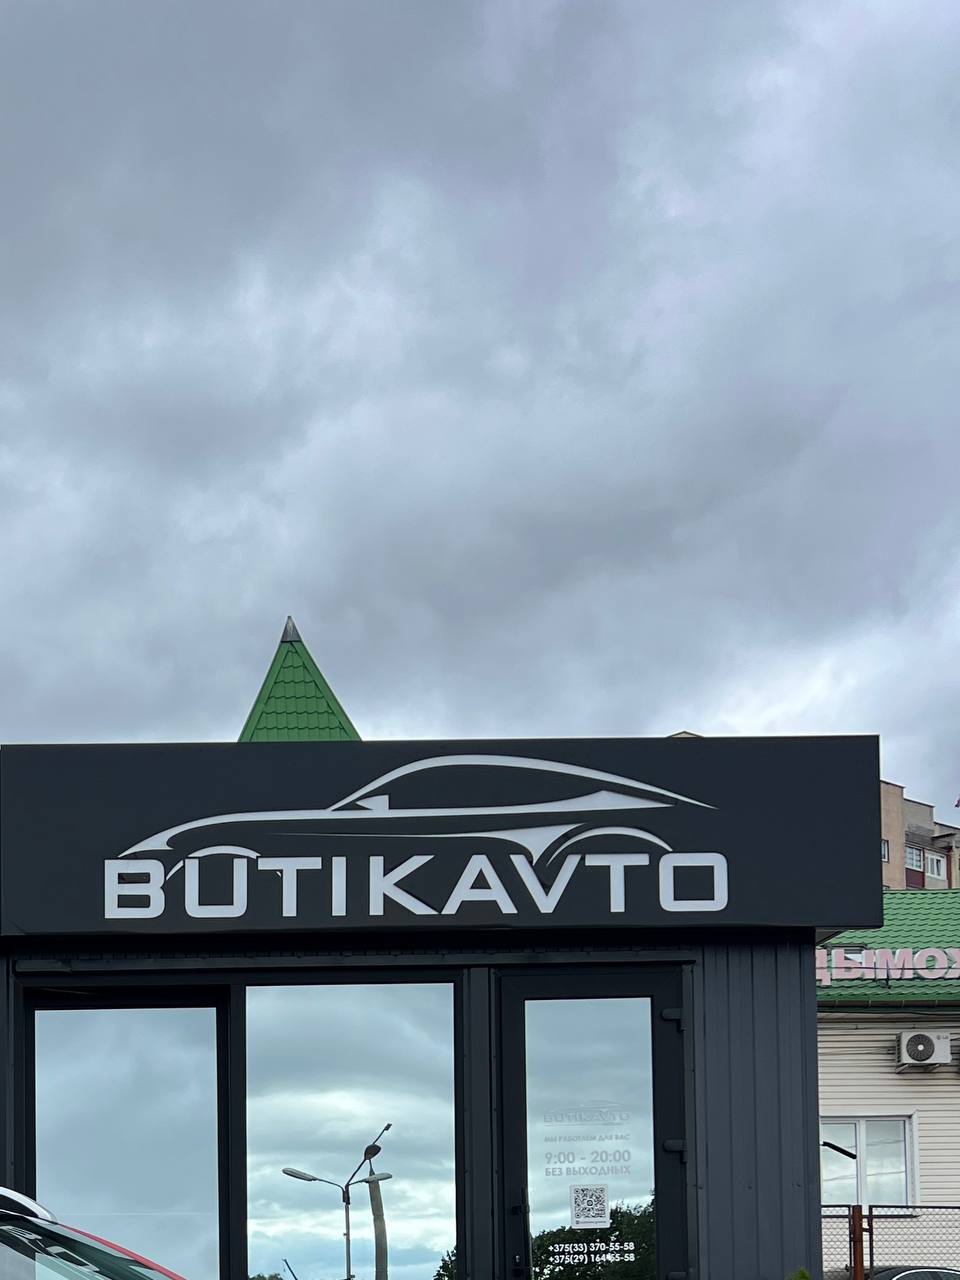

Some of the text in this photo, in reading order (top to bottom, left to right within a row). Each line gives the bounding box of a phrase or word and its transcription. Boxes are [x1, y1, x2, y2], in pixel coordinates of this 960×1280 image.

[105, 853, 728, 919] BUTIKAVTO
[545, 1152, 576, 1164] 9:00
[590, 1150, 631, 1163] 20:00
[545, 1166, 631, 1176] БЕЗ ВЫХОДНЫХ
[548, 1241, 635, 1253] +375(33) 370-55-58
[548, 1254, 588, 1264] +375(29)
